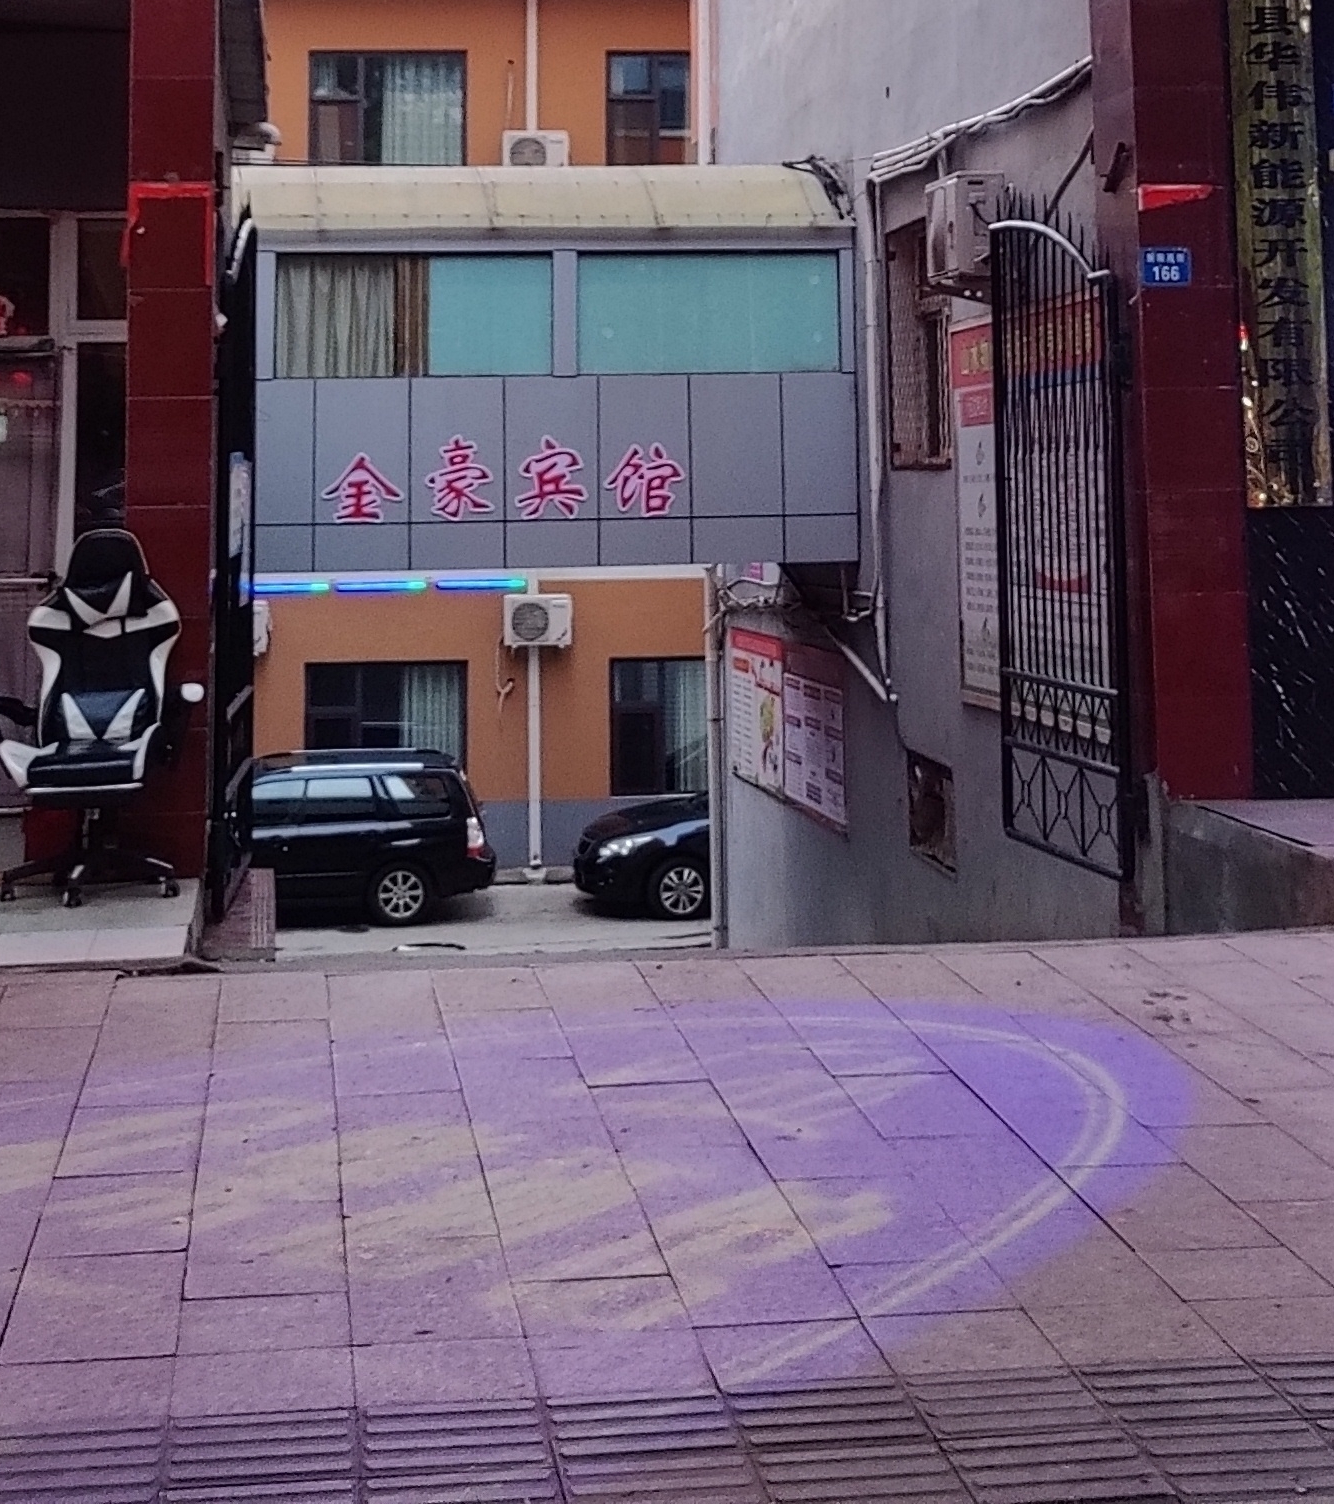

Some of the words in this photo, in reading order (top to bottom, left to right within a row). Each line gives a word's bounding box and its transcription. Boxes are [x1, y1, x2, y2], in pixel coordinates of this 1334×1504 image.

[1152, 265, 1181, 282] 166
[321, 434, 684, 524] 金豪宾馆
